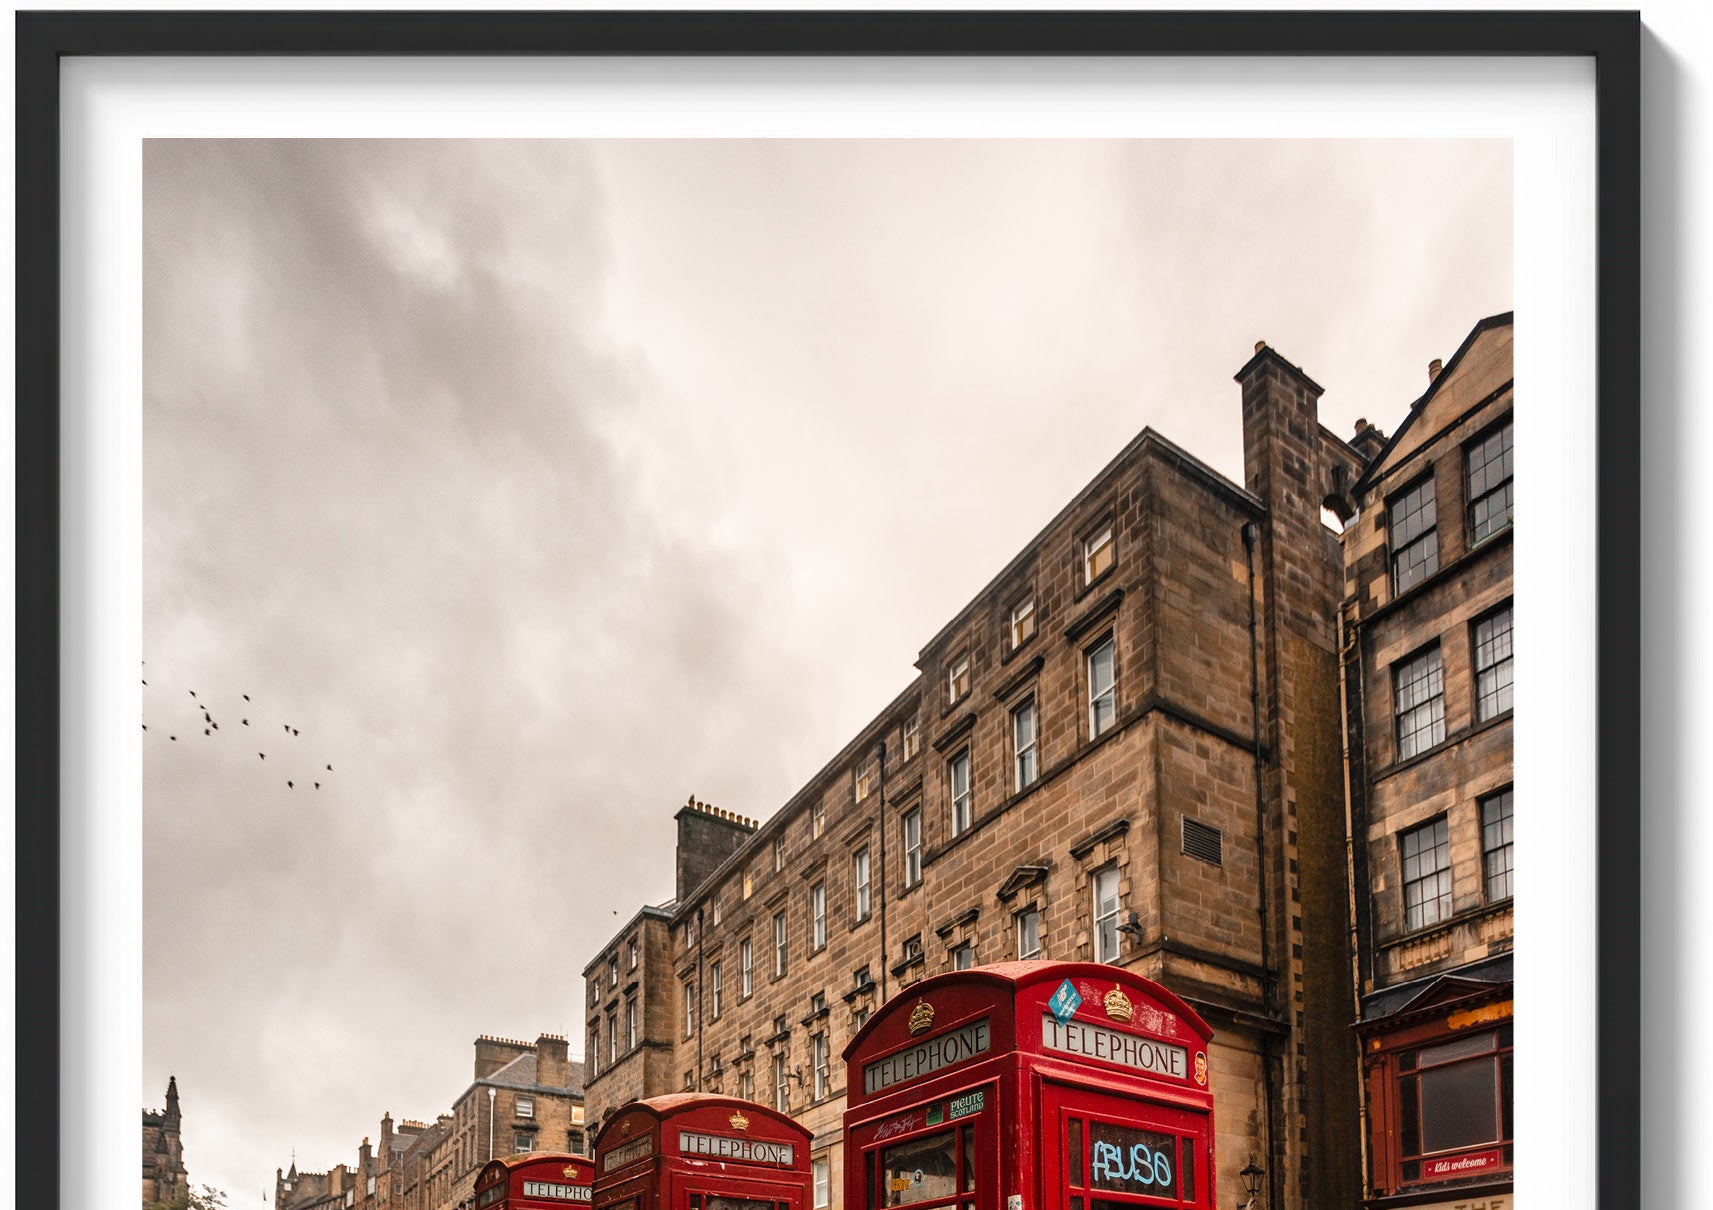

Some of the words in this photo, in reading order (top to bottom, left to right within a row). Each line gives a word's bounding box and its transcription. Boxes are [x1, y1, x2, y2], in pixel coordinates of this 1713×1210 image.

[868, 1024, 987, 1091] TELEPHONE
[1047, 1020, 1181, 1076] TELEPHONE
[683, 1134, 789, 1164] TELEPHONE
[1434, 1162, 1450, 1173] Kids
[1451, 1157, 1487, 1170] welcome
